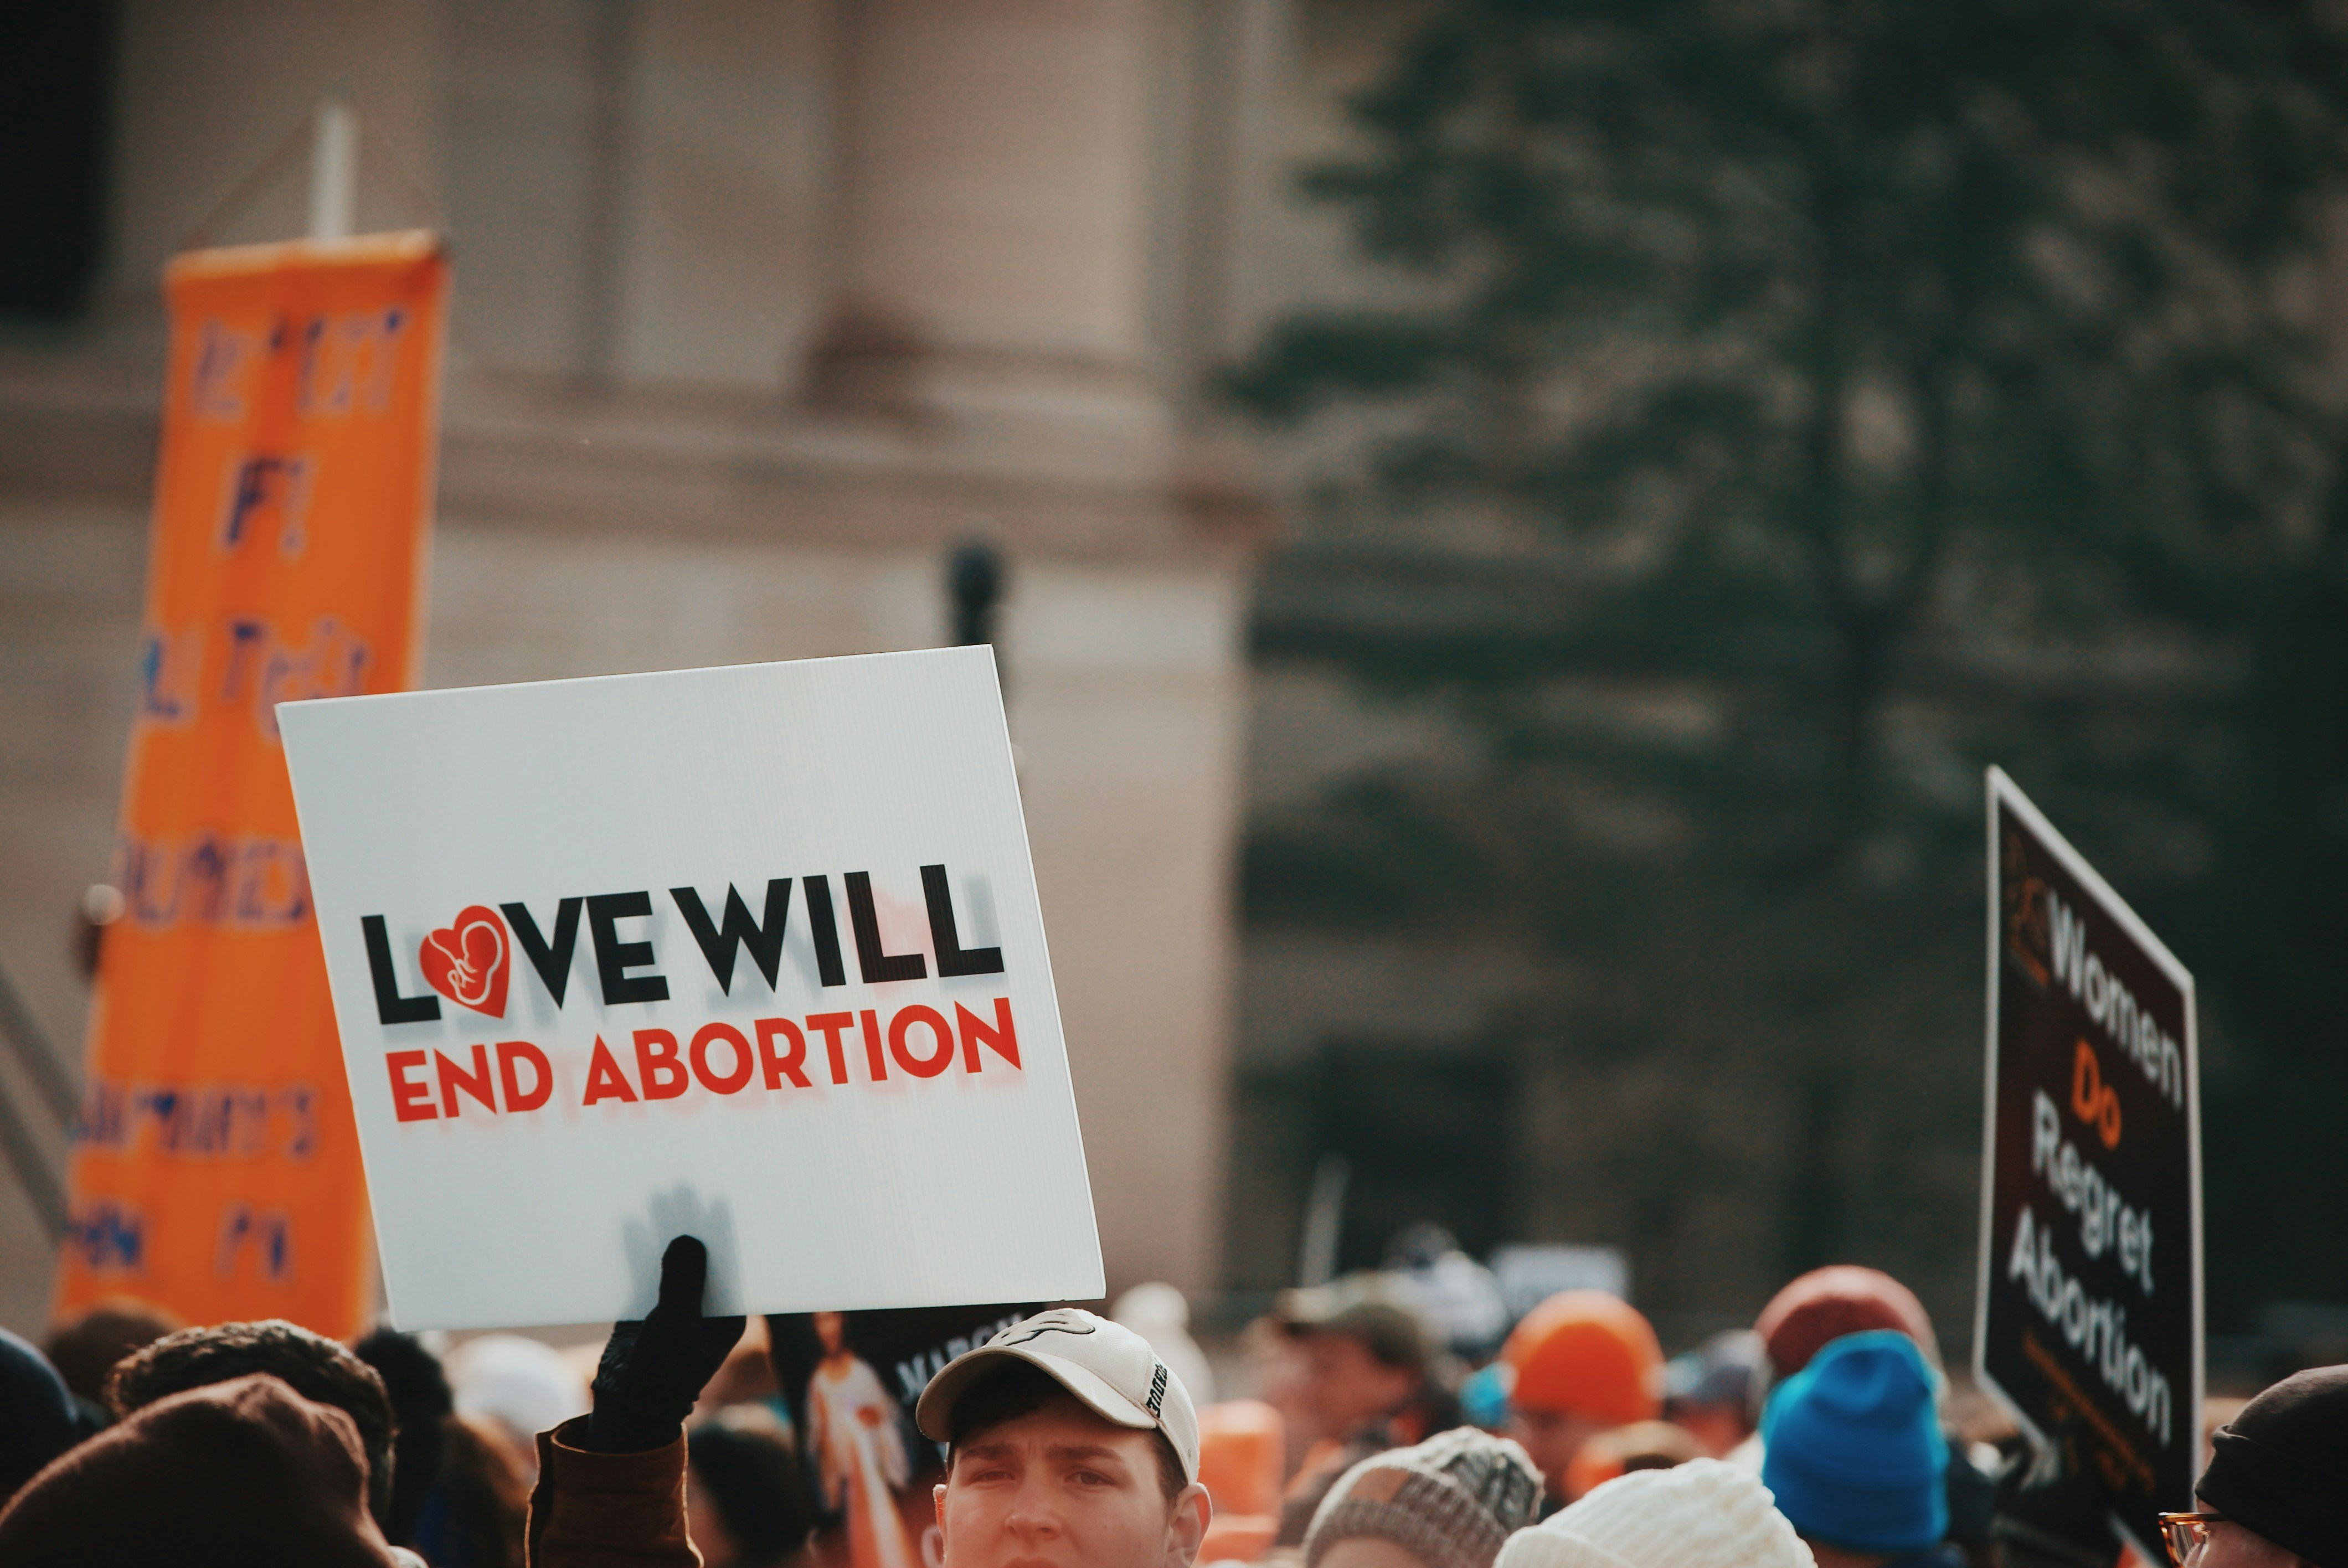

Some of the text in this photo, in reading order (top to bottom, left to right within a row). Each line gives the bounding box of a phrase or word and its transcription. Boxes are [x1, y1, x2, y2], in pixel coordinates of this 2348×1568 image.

[668, 863, 1005, 998] WILL
[2047, 890, 2183, 1109] Women
[386, 1041, 553, 1122] END
[583, 997, 1022, 1106] ABORTION
[2071, 1039, 2122, 1149] Do
[2031, 1089, 2154, 1294] Regret
[2007, 1205, 2172, 1444] Abortion
